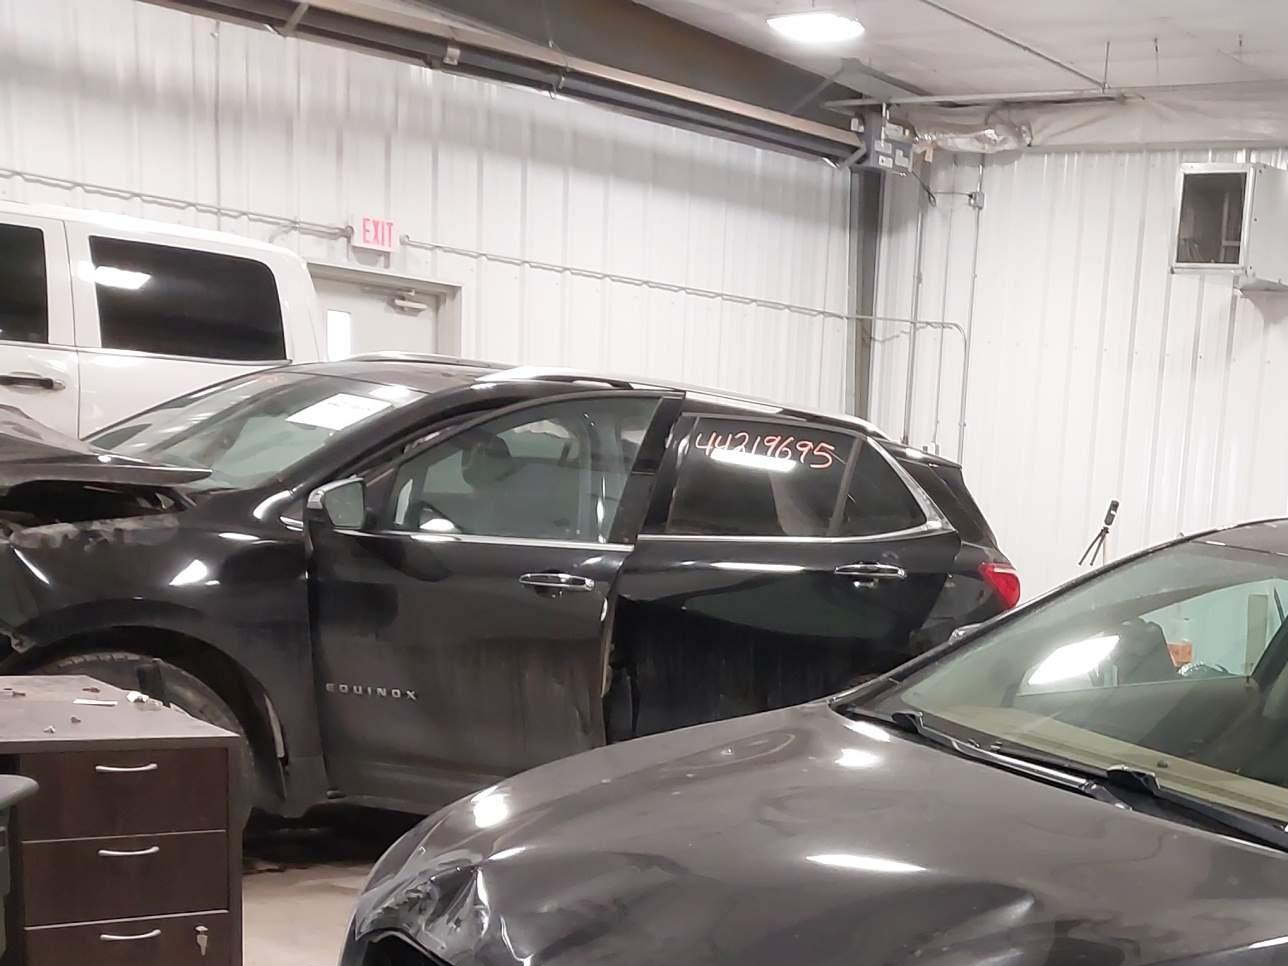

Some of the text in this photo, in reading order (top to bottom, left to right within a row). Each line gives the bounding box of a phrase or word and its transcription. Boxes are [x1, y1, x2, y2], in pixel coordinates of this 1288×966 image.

[362, 217, 394, 248] EXIT
[695, 432, 836, 469] 44219695
[325, 682, 417, 701] EQUINOX
